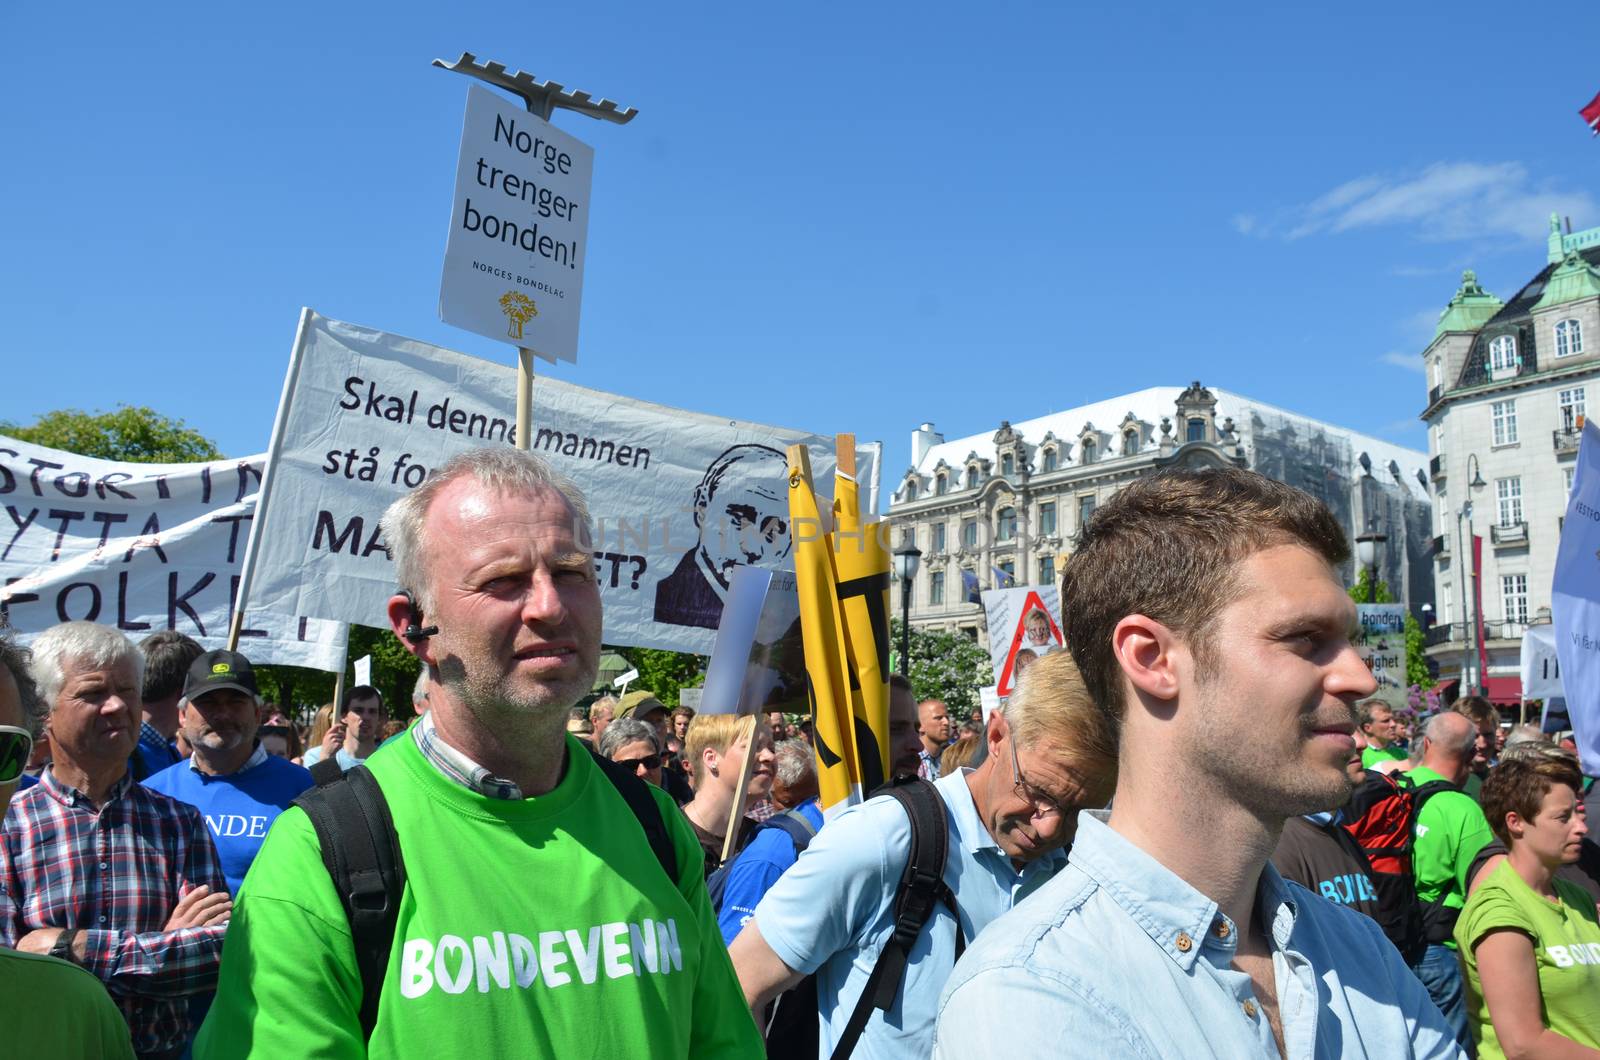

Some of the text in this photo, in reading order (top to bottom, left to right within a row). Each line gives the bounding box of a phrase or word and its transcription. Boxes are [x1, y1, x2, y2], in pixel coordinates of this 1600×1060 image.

[493, 112, 572, 175] Norge
[476, 157, 578, 222] trenger
[463, 198, 577, 270] bonden!
[472, 260, 565, 299] NORGES BONDELAG
[339, 376, 651, 470] Skal denne mannen
[322, 446, 380, 482] stå
[1362, 611, 1401, 626] bonden
[400, 918, 682, 999] BONDEVENN
